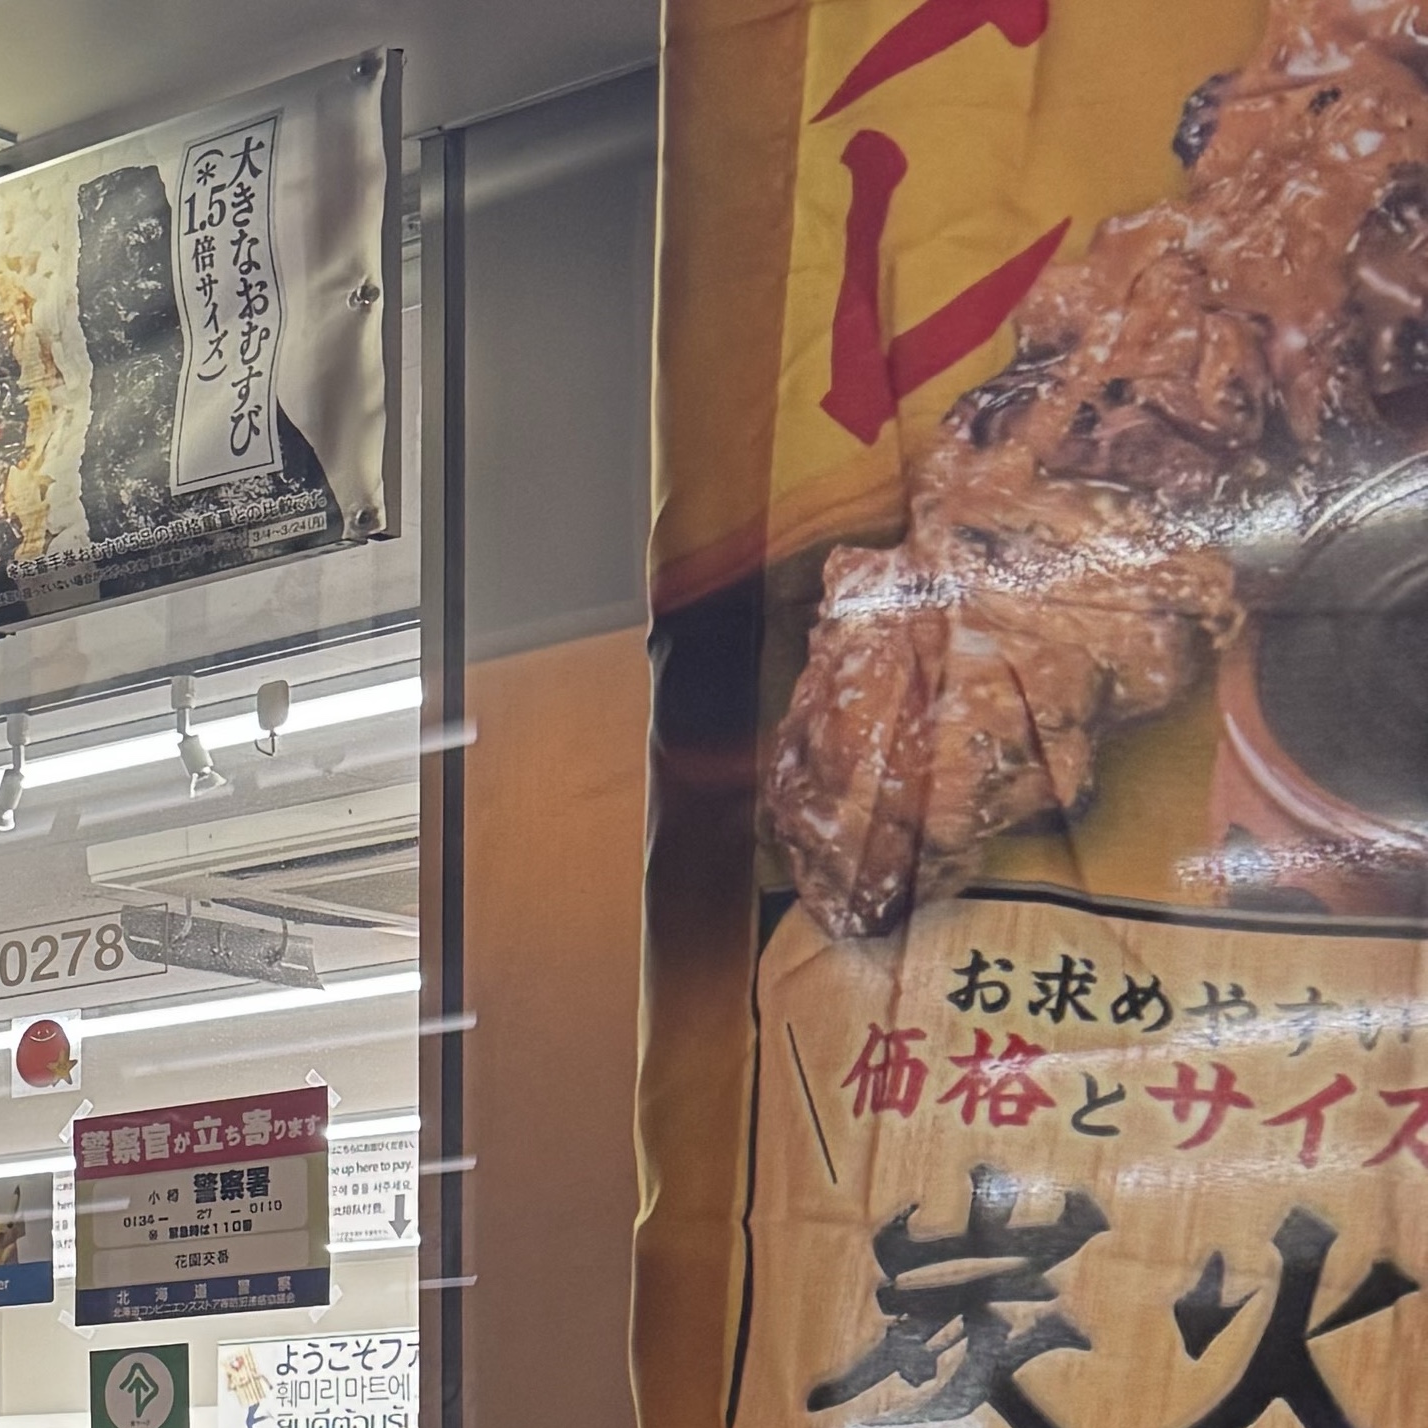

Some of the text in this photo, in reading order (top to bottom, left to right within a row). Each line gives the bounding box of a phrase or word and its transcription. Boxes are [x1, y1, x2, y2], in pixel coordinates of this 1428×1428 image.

[227, 137, 270, 456] 大きなおむすび
[80, 1108, 321, 1167] 警察官が立ち寄ります
[193, 1166, 270, 1204] 警察署
[356, 1161, 379, 1173] here
